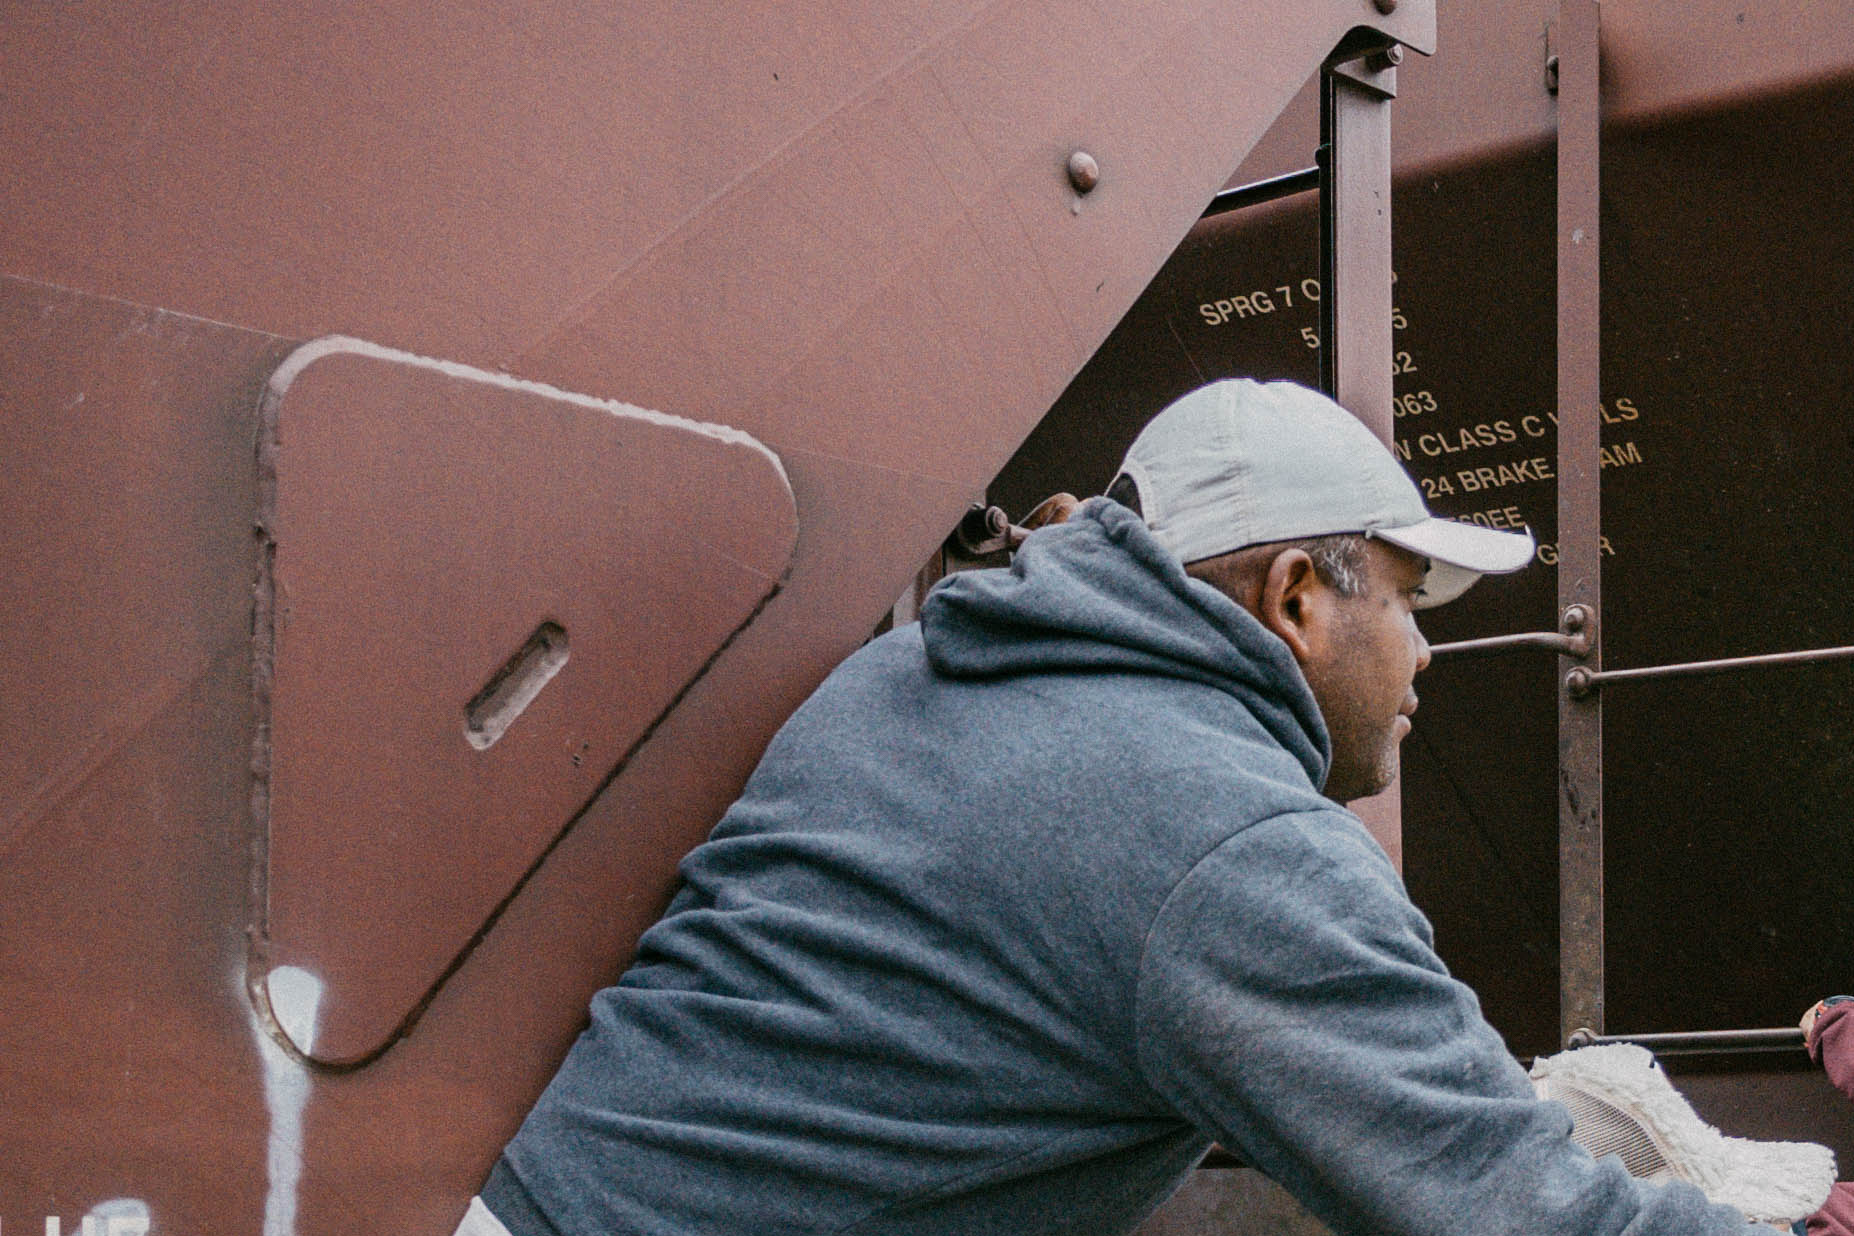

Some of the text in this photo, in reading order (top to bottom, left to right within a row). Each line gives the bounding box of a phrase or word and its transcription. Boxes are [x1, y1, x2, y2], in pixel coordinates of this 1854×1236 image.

[1200, 292, 1275, 325] SPRG
[1276, 286, 1293, 307] 7
[1419, 421, 1516, 457] CLASS
[1522, 416, 1545, 437] C
[1421, 476, 1454, 499] 24
[1457, 458, 1554, 492] BRAKE
